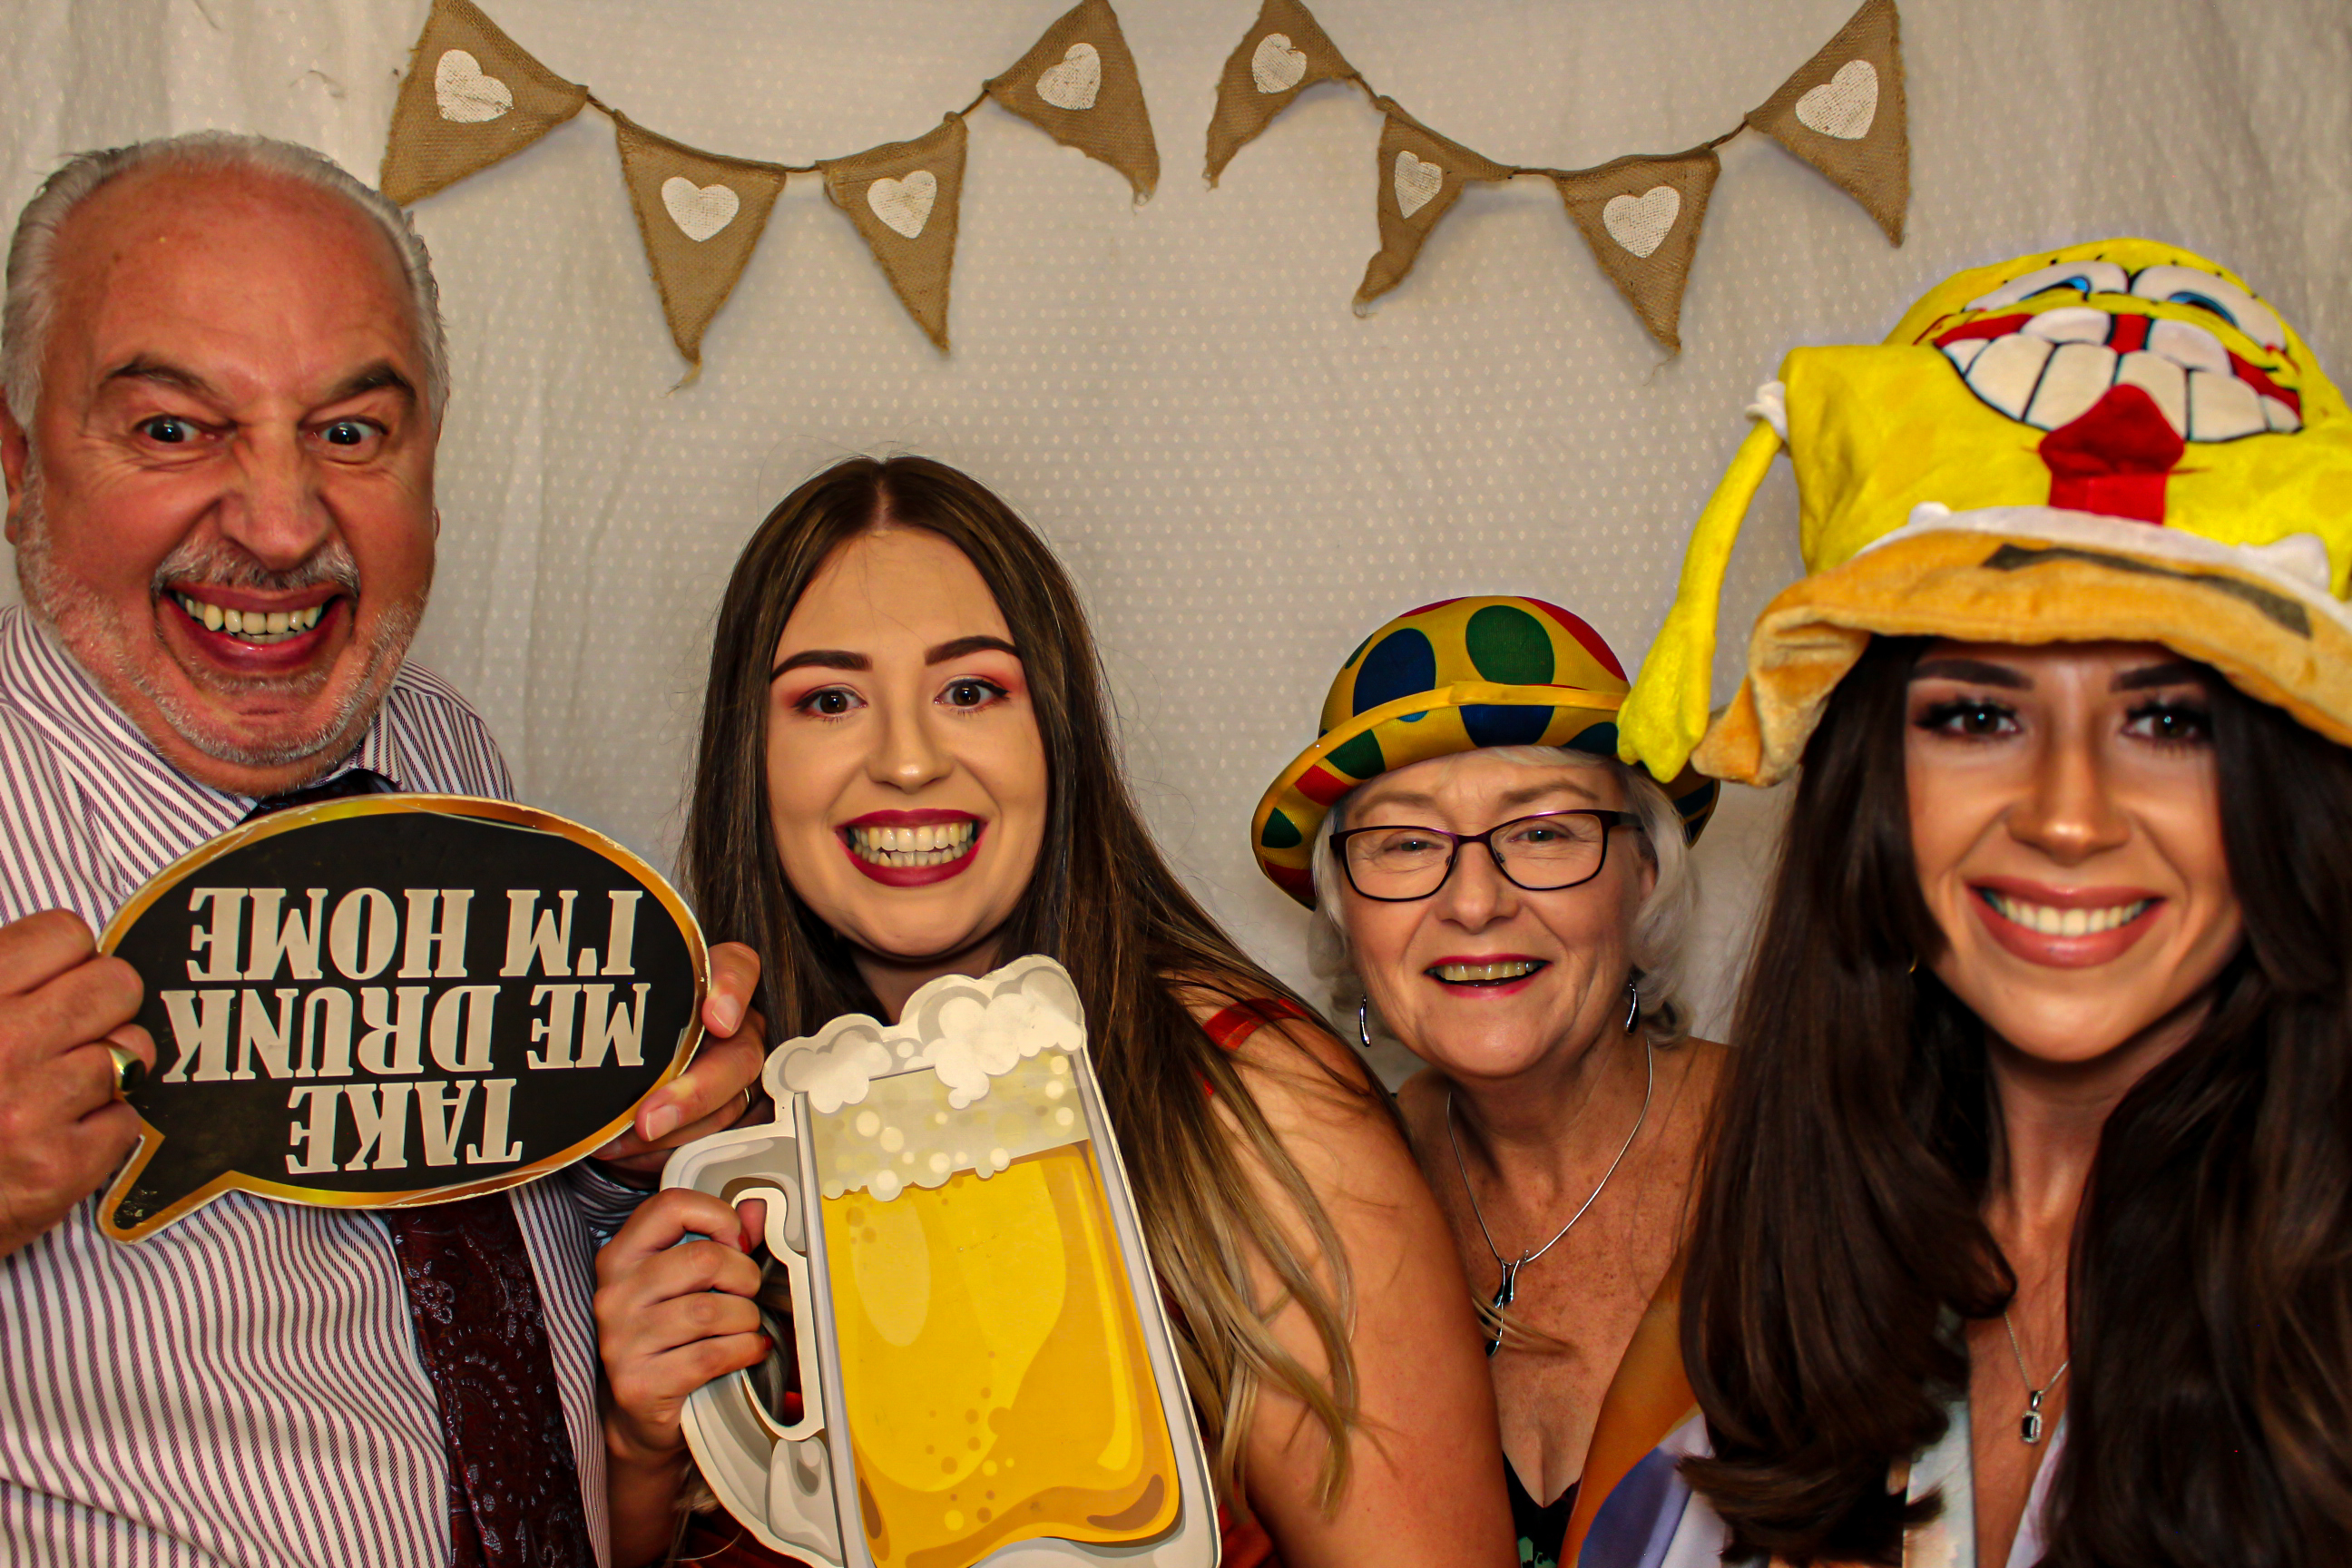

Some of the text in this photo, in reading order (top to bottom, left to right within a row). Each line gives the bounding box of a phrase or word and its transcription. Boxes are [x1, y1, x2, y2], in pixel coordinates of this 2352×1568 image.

[187, 887, 643, 981] I'M HOME
[161, 983, 652, 1083] ME DRUNK
[286, 1078, 523, 1174] TAKE
